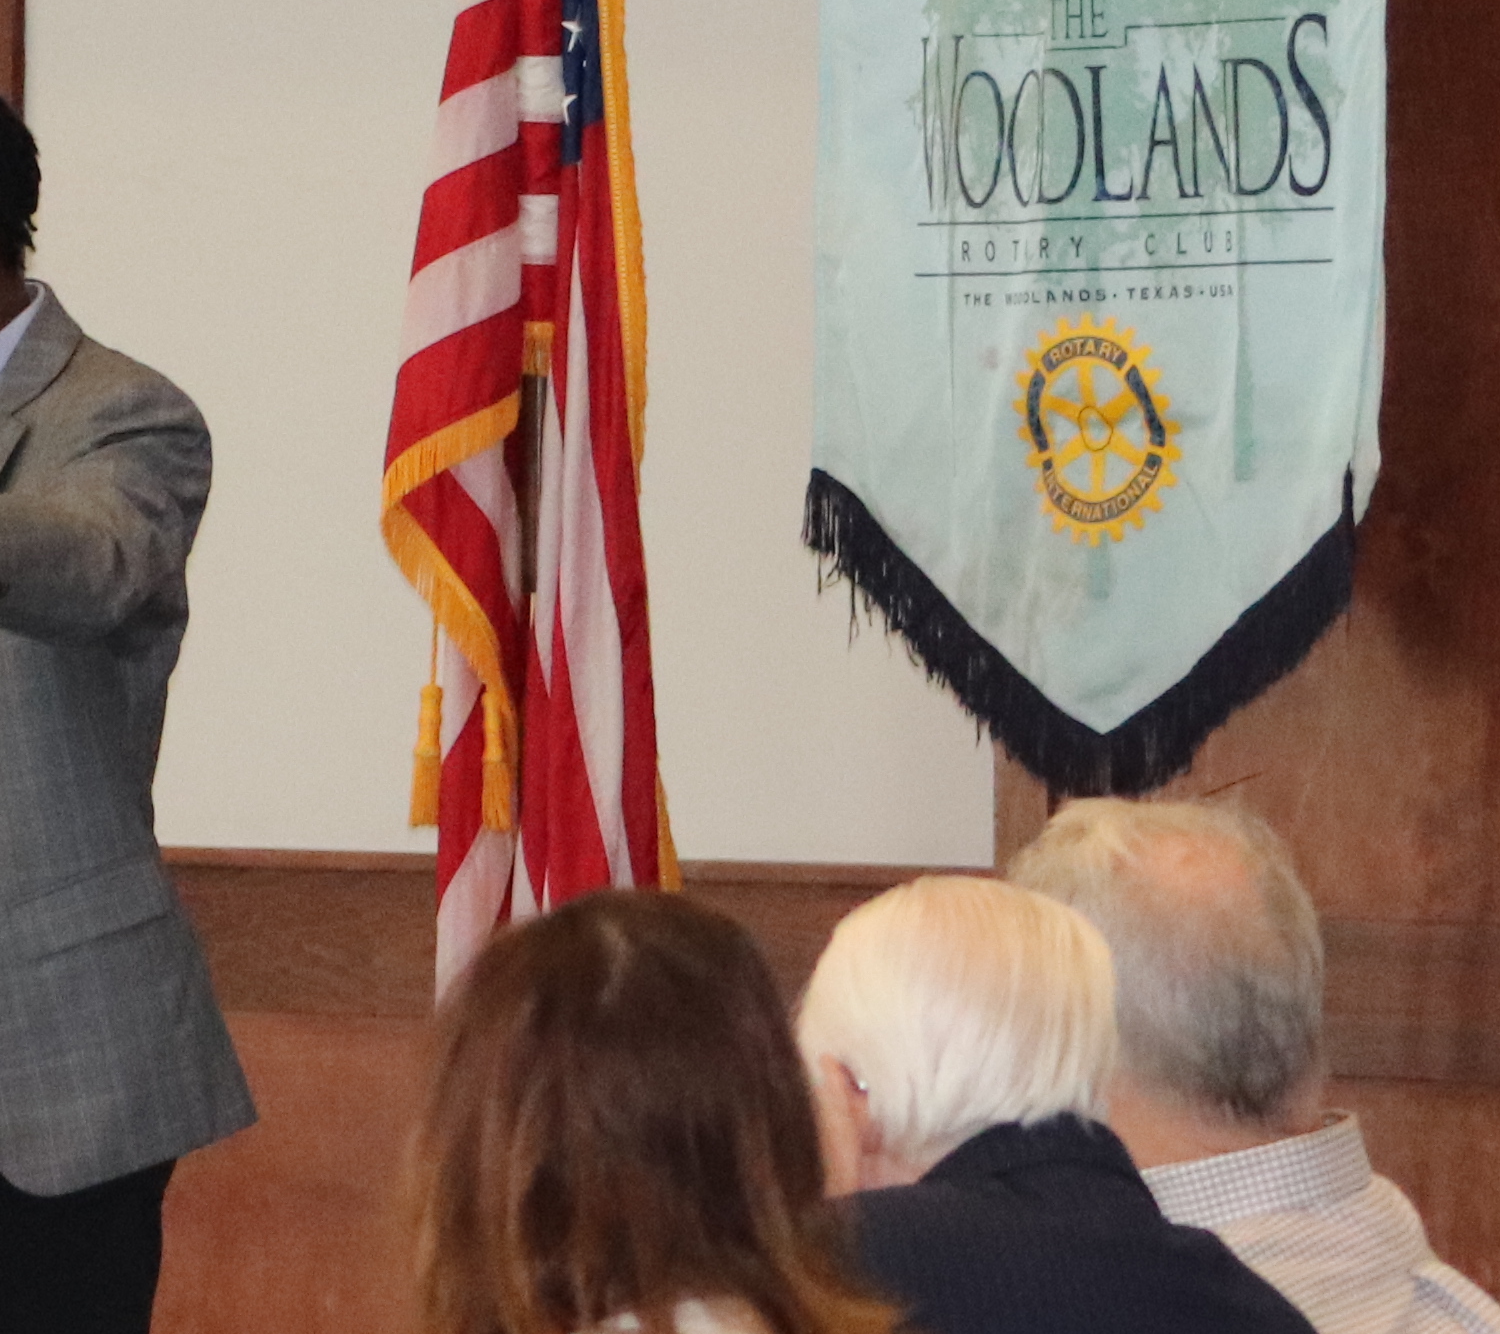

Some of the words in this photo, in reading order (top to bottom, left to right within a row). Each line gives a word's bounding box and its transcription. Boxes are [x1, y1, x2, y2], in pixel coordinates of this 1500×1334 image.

[920, 12, 1332, 214] WOODLANDS
[961, 235, 1084, 262] ROTRY
[1144, 230, 1233, 256] CLUB
[963, 293, 992, 307] THE
[1126, 284, 1194, 301] TEXAS
[1209, 283, 1233, 298] USA
[1049, 338, 1122, 365] ROTARY
